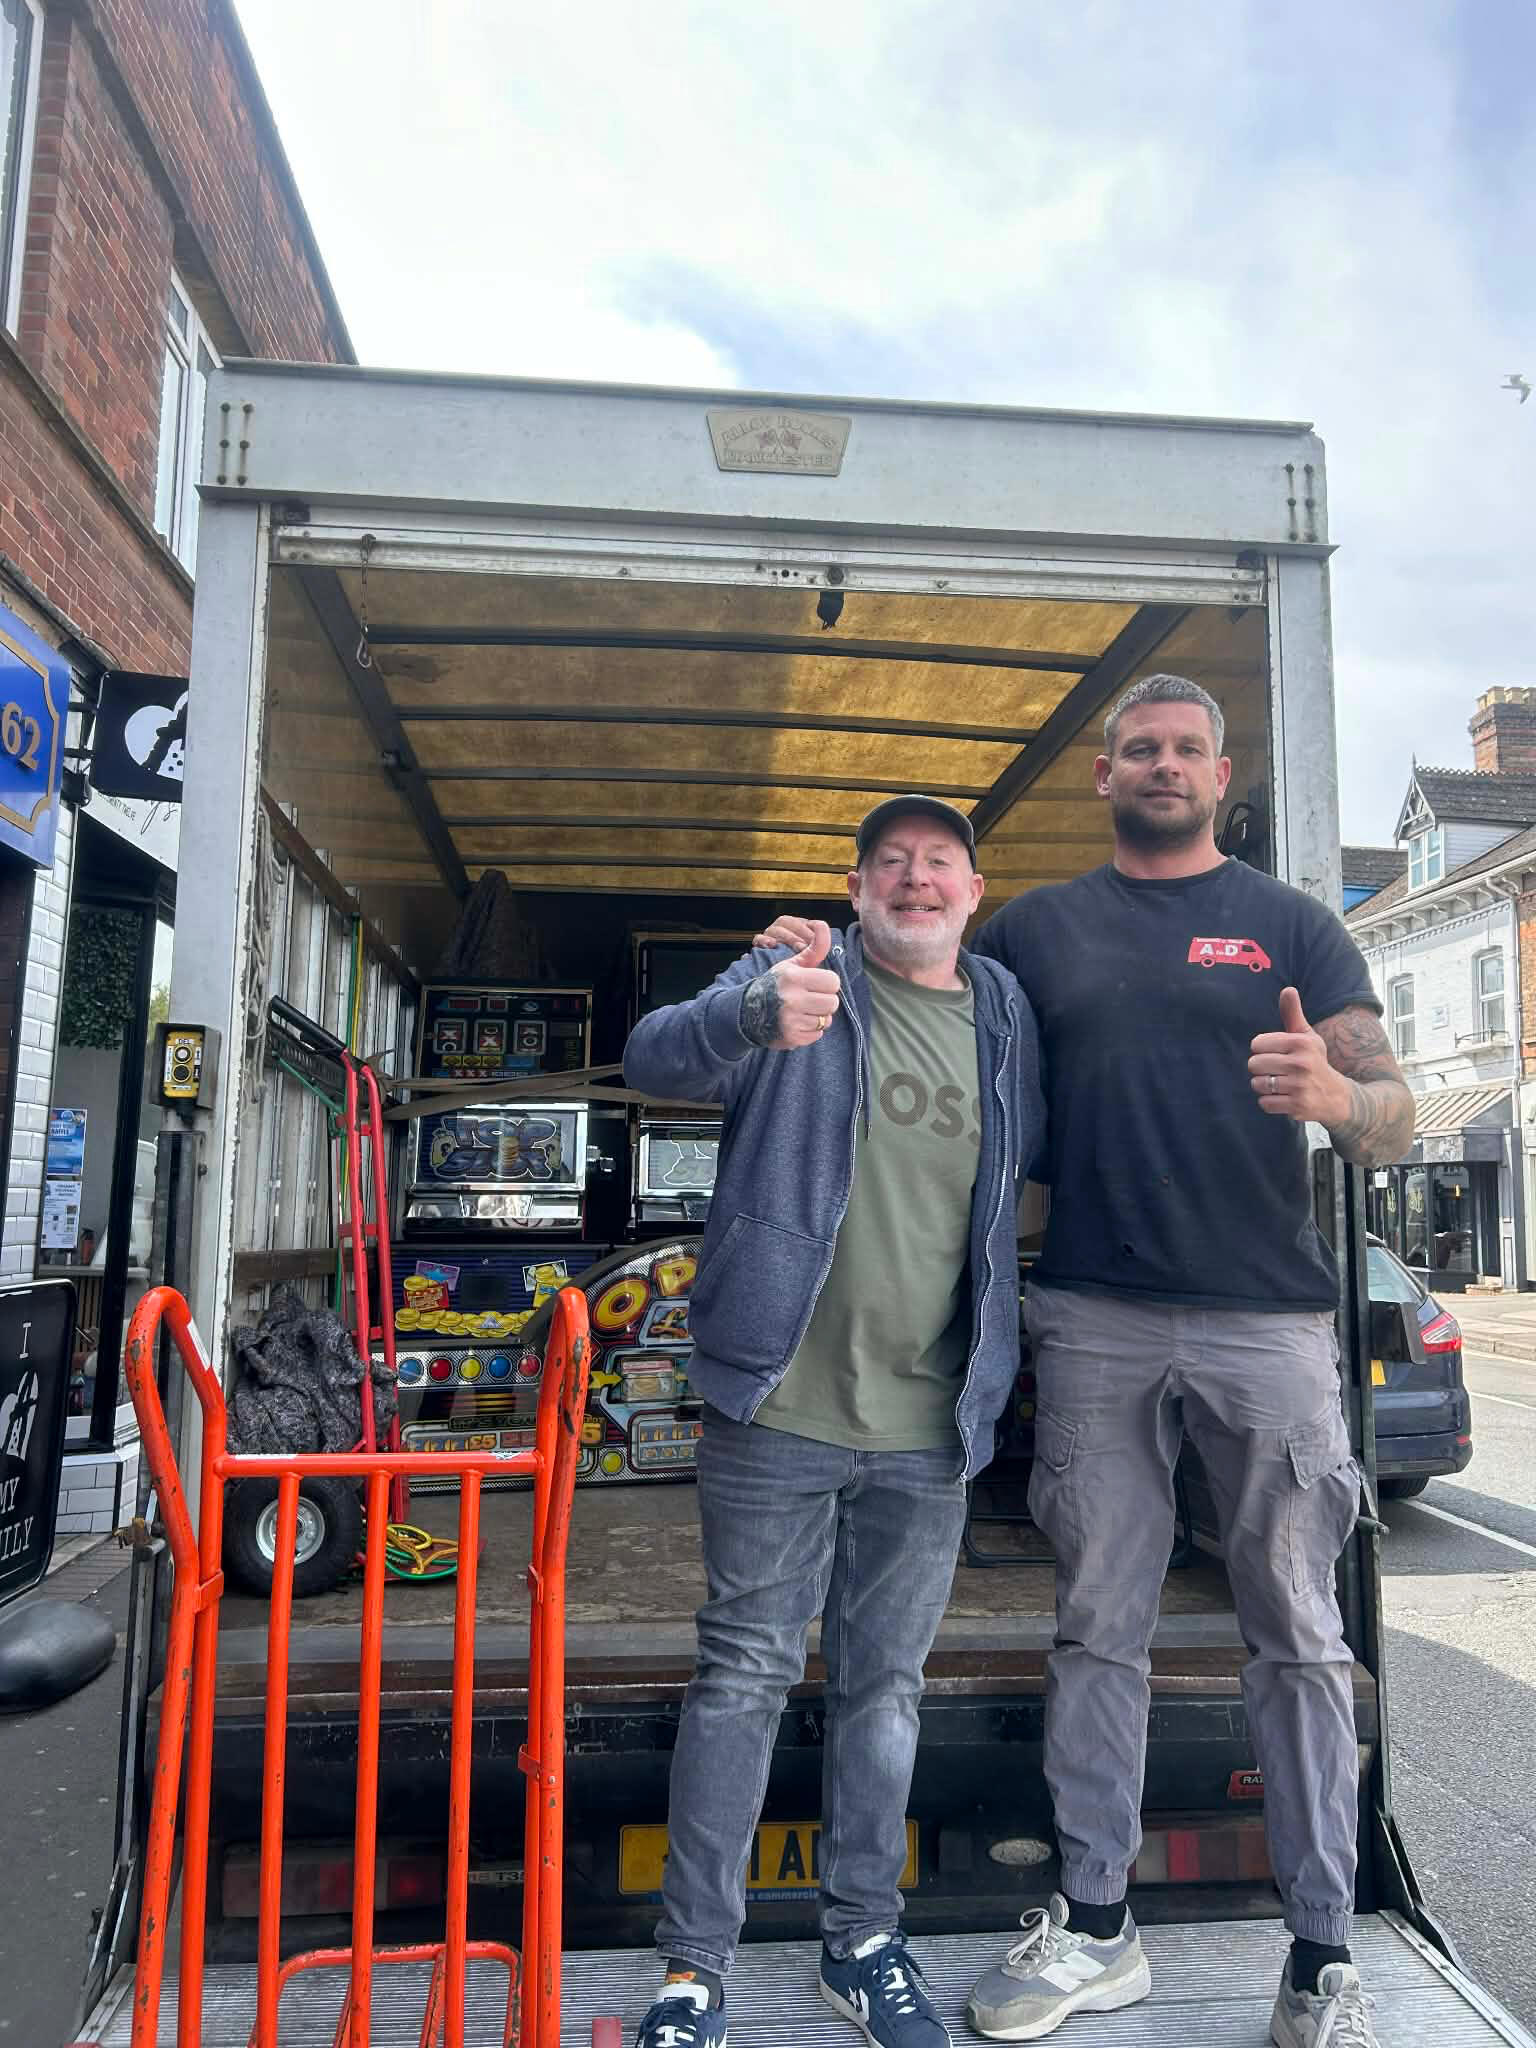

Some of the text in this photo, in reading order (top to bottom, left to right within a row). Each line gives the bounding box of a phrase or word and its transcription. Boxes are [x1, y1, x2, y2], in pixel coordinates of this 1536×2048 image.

[2, 702, 40, 770] 62
[879, 1071, 981, 1147] OS
[20, 1322, 32, 1359] I
[0, 1515, 34, 1561] ILY
